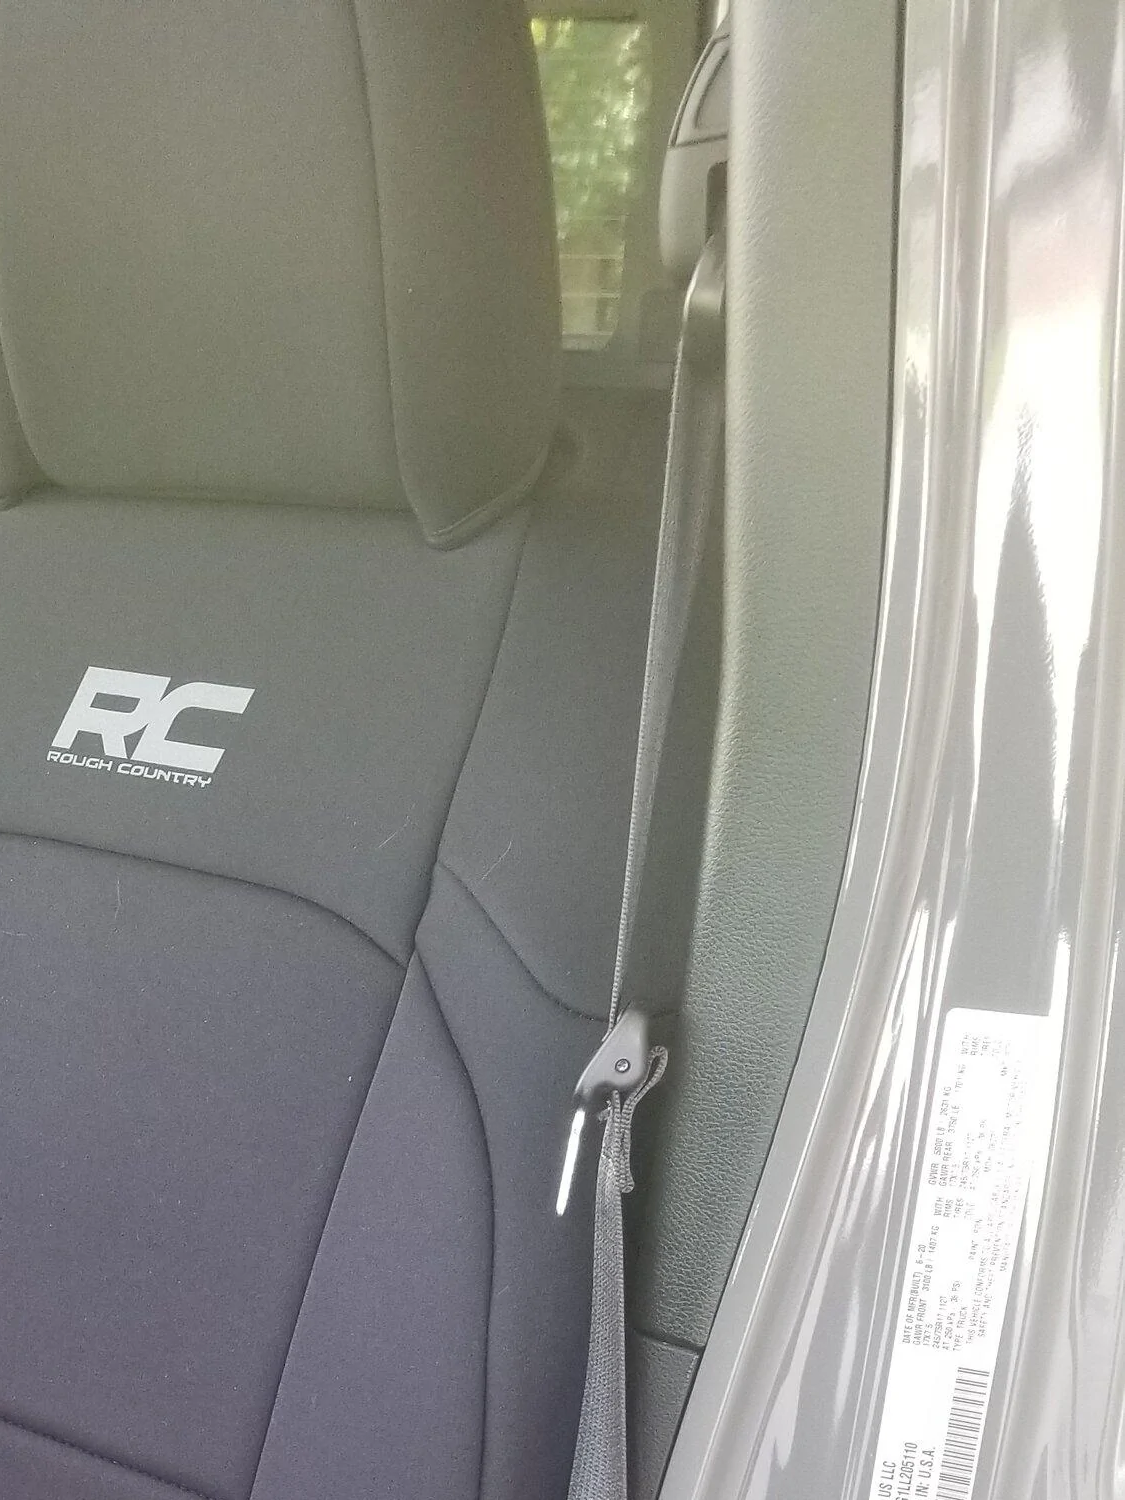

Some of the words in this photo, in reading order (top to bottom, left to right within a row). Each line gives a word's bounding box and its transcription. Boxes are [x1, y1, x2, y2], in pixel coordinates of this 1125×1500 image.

[51, 665, 256, 773] RC
[46, 749, 113, 772] ROUGH
[116, 762, 212, 788] COUNTRY
[880, 1460, 896, 1480] LLC
[918, 1444, 935, 1478] U.S.A.
[878, 1482, 892, 1497] US
[915, 1481, 929, 1497] IN:
